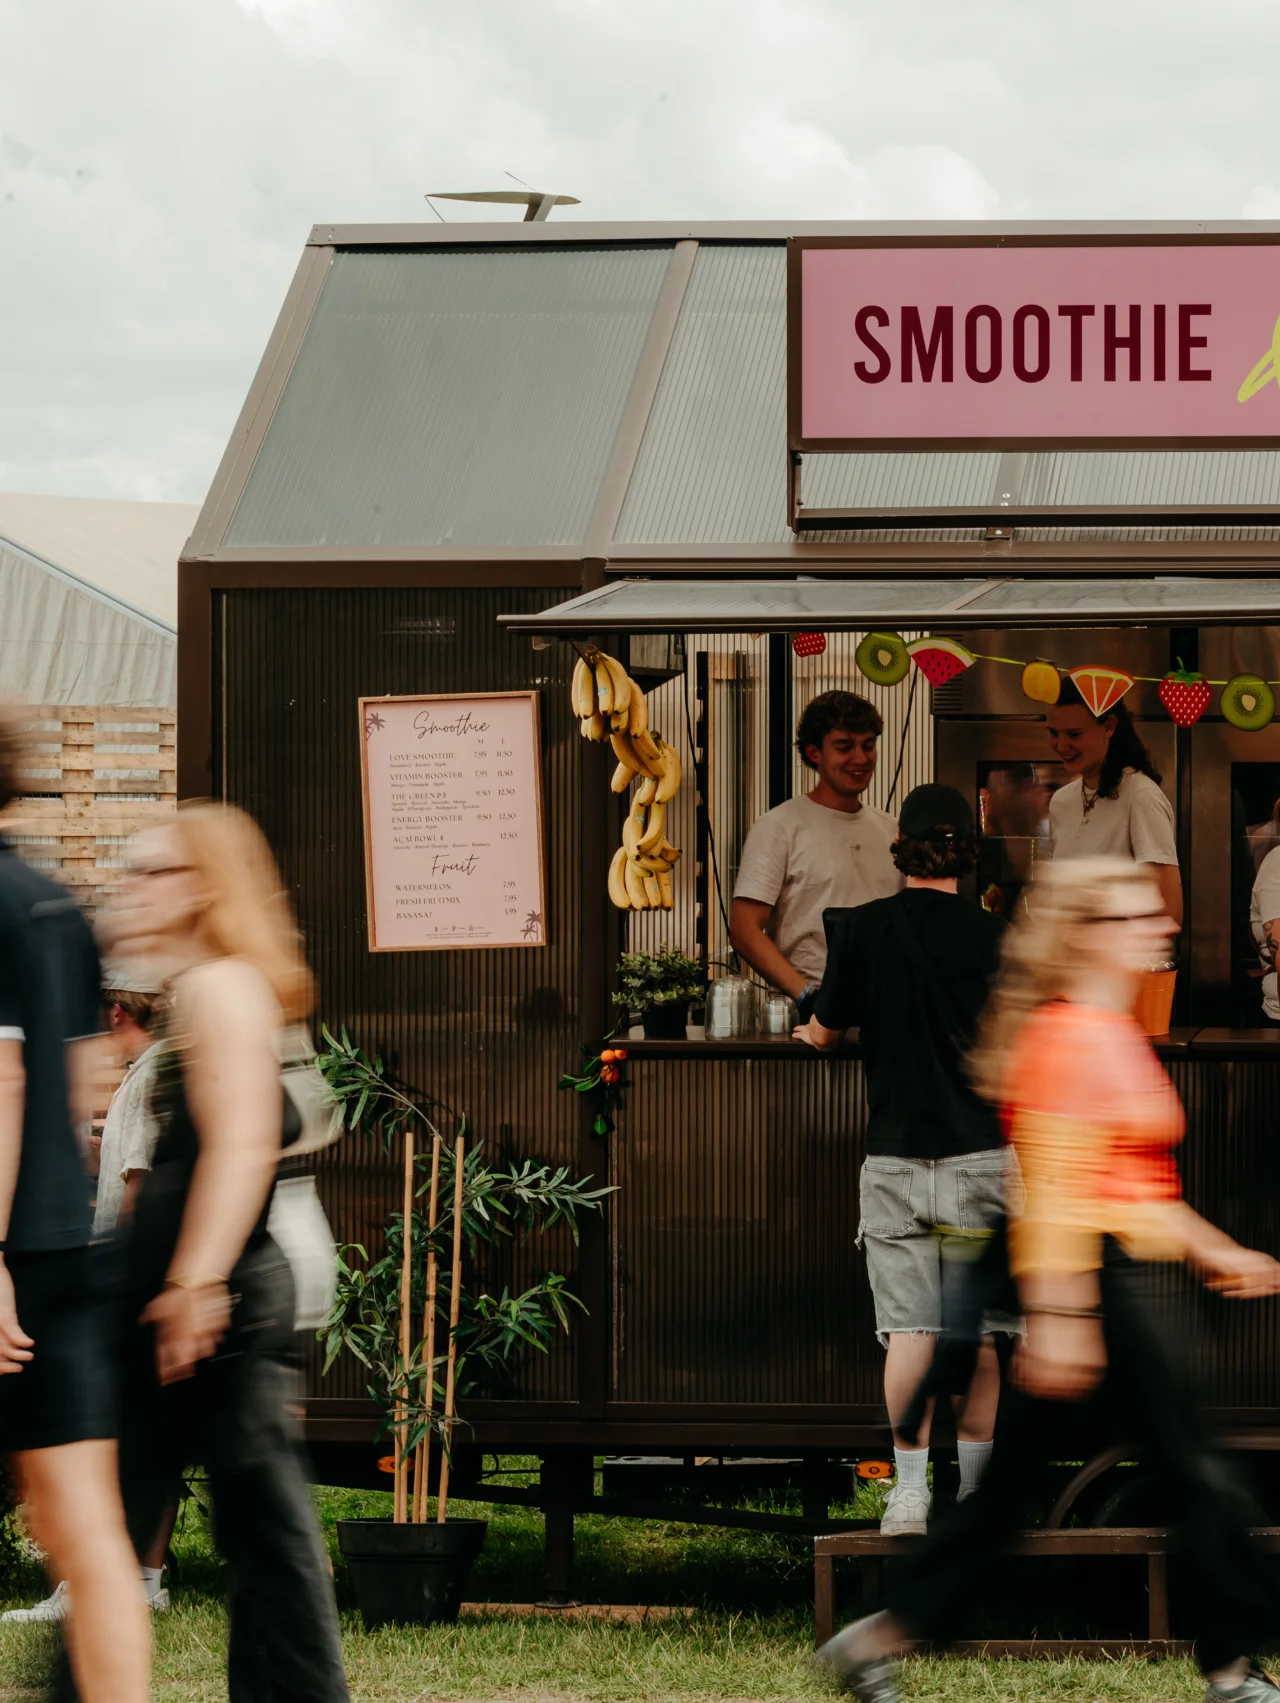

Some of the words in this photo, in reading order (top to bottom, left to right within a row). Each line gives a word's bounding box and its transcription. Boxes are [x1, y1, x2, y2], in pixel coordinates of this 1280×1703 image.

[853, 304, 1212, 383] SMOOTHIE
[413, 710, 491, 739] Smoothie
[413, 752, 456, 760] SMOOTHIE
[390, 773, 423, 781] VITAMIN
[425, 771, 463, 780] BOOSTER
[408, 792, 436, 800] GREEN
[391, 816, 423, 824] ENERGY
[425, 814, 464, 823] BOOSTER
[476, 813, 492, 821] 9,50
[414, 835, 437, 843] BOWL
[500, 832, 518, 840] 12,50
[431, 853, 481, 877] Fruit
[395, 883, 451, 891] WATERMELON
[503, 880, 516, 888] 7,95
[395, 898, 421, 906] FRESH
[423, 896, 461, 905] FRUITMIX
[504, 894, 517, 902] 7,95
[396, 911, 433, 919] BANANA?
